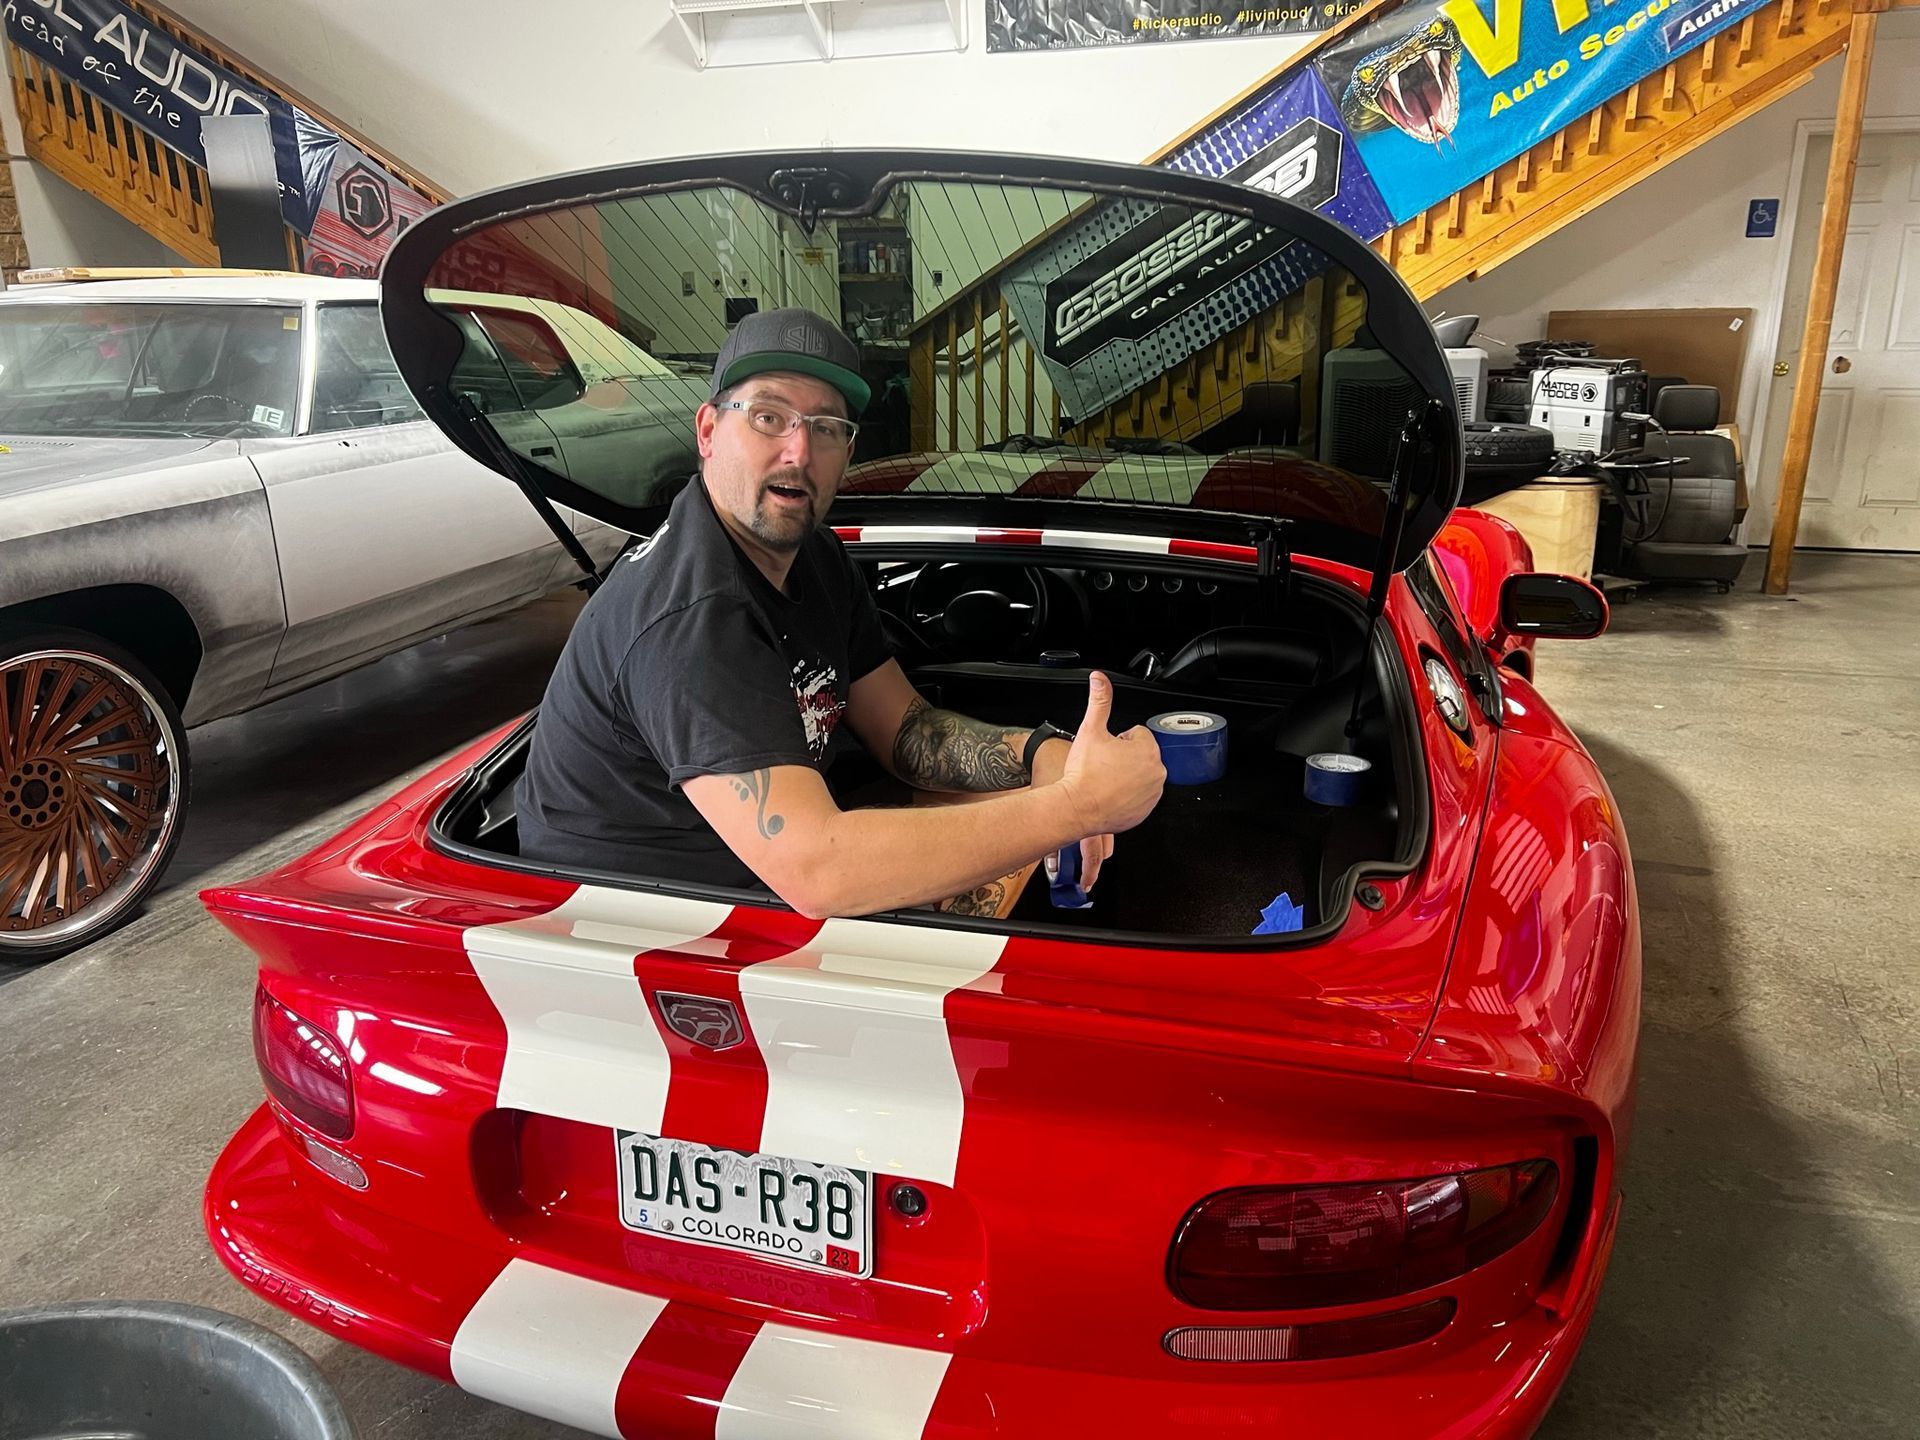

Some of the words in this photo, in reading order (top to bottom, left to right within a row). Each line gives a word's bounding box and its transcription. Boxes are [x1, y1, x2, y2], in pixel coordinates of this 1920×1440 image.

[1132, 13, 1223, 31] #kickeraudio
[1237, 6, 1309, 23] #livinloud
[1678, 0, 1746, 41] Auth
[1489, 59, 1570, 119] Auto
[1579, 0, 1680, 61] Secu
[82, 55, 121, 84] of
[133, 87, 181, 128] the
[1130, 282, 1187, 320] CAR
[1541, 380, 1579, 391] MATCO
[1541, 388, 1579, 400] TOOLS
[639, 1208, 649, 1223] 5
[682, 1216, 804, 1253] COLORADO
[831, 1248, 850, 1267] 23
